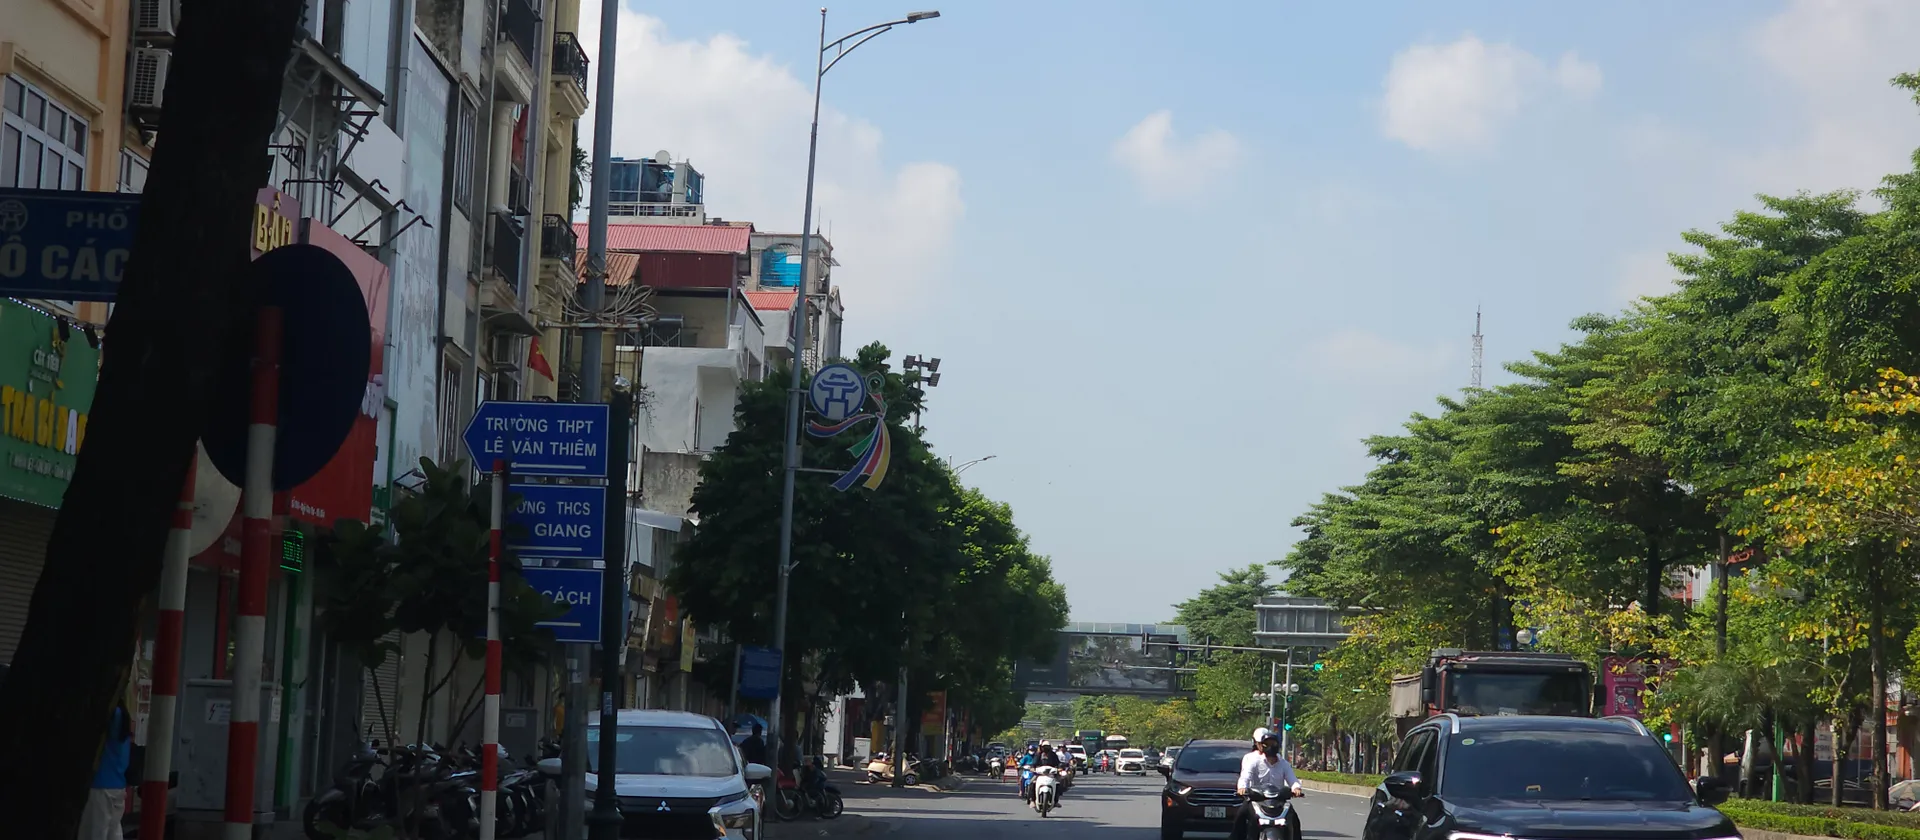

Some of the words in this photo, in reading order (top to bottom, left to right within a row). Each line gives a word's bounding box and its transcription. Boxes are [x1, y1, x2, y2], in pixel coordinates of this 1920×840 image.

[66, 204, 131, 231] PHỐ
[41, 237, 131, 283] CÁC
[557, 420, 594, 434] THPT
[484, 436, 504, 454] LÊ
[511, 437, 543, 455] VĂN
[549, 438, 597, 457] THIÊM
[557, 501, 591, 516] THCS
[534, 523, 592, 539] GIANG
